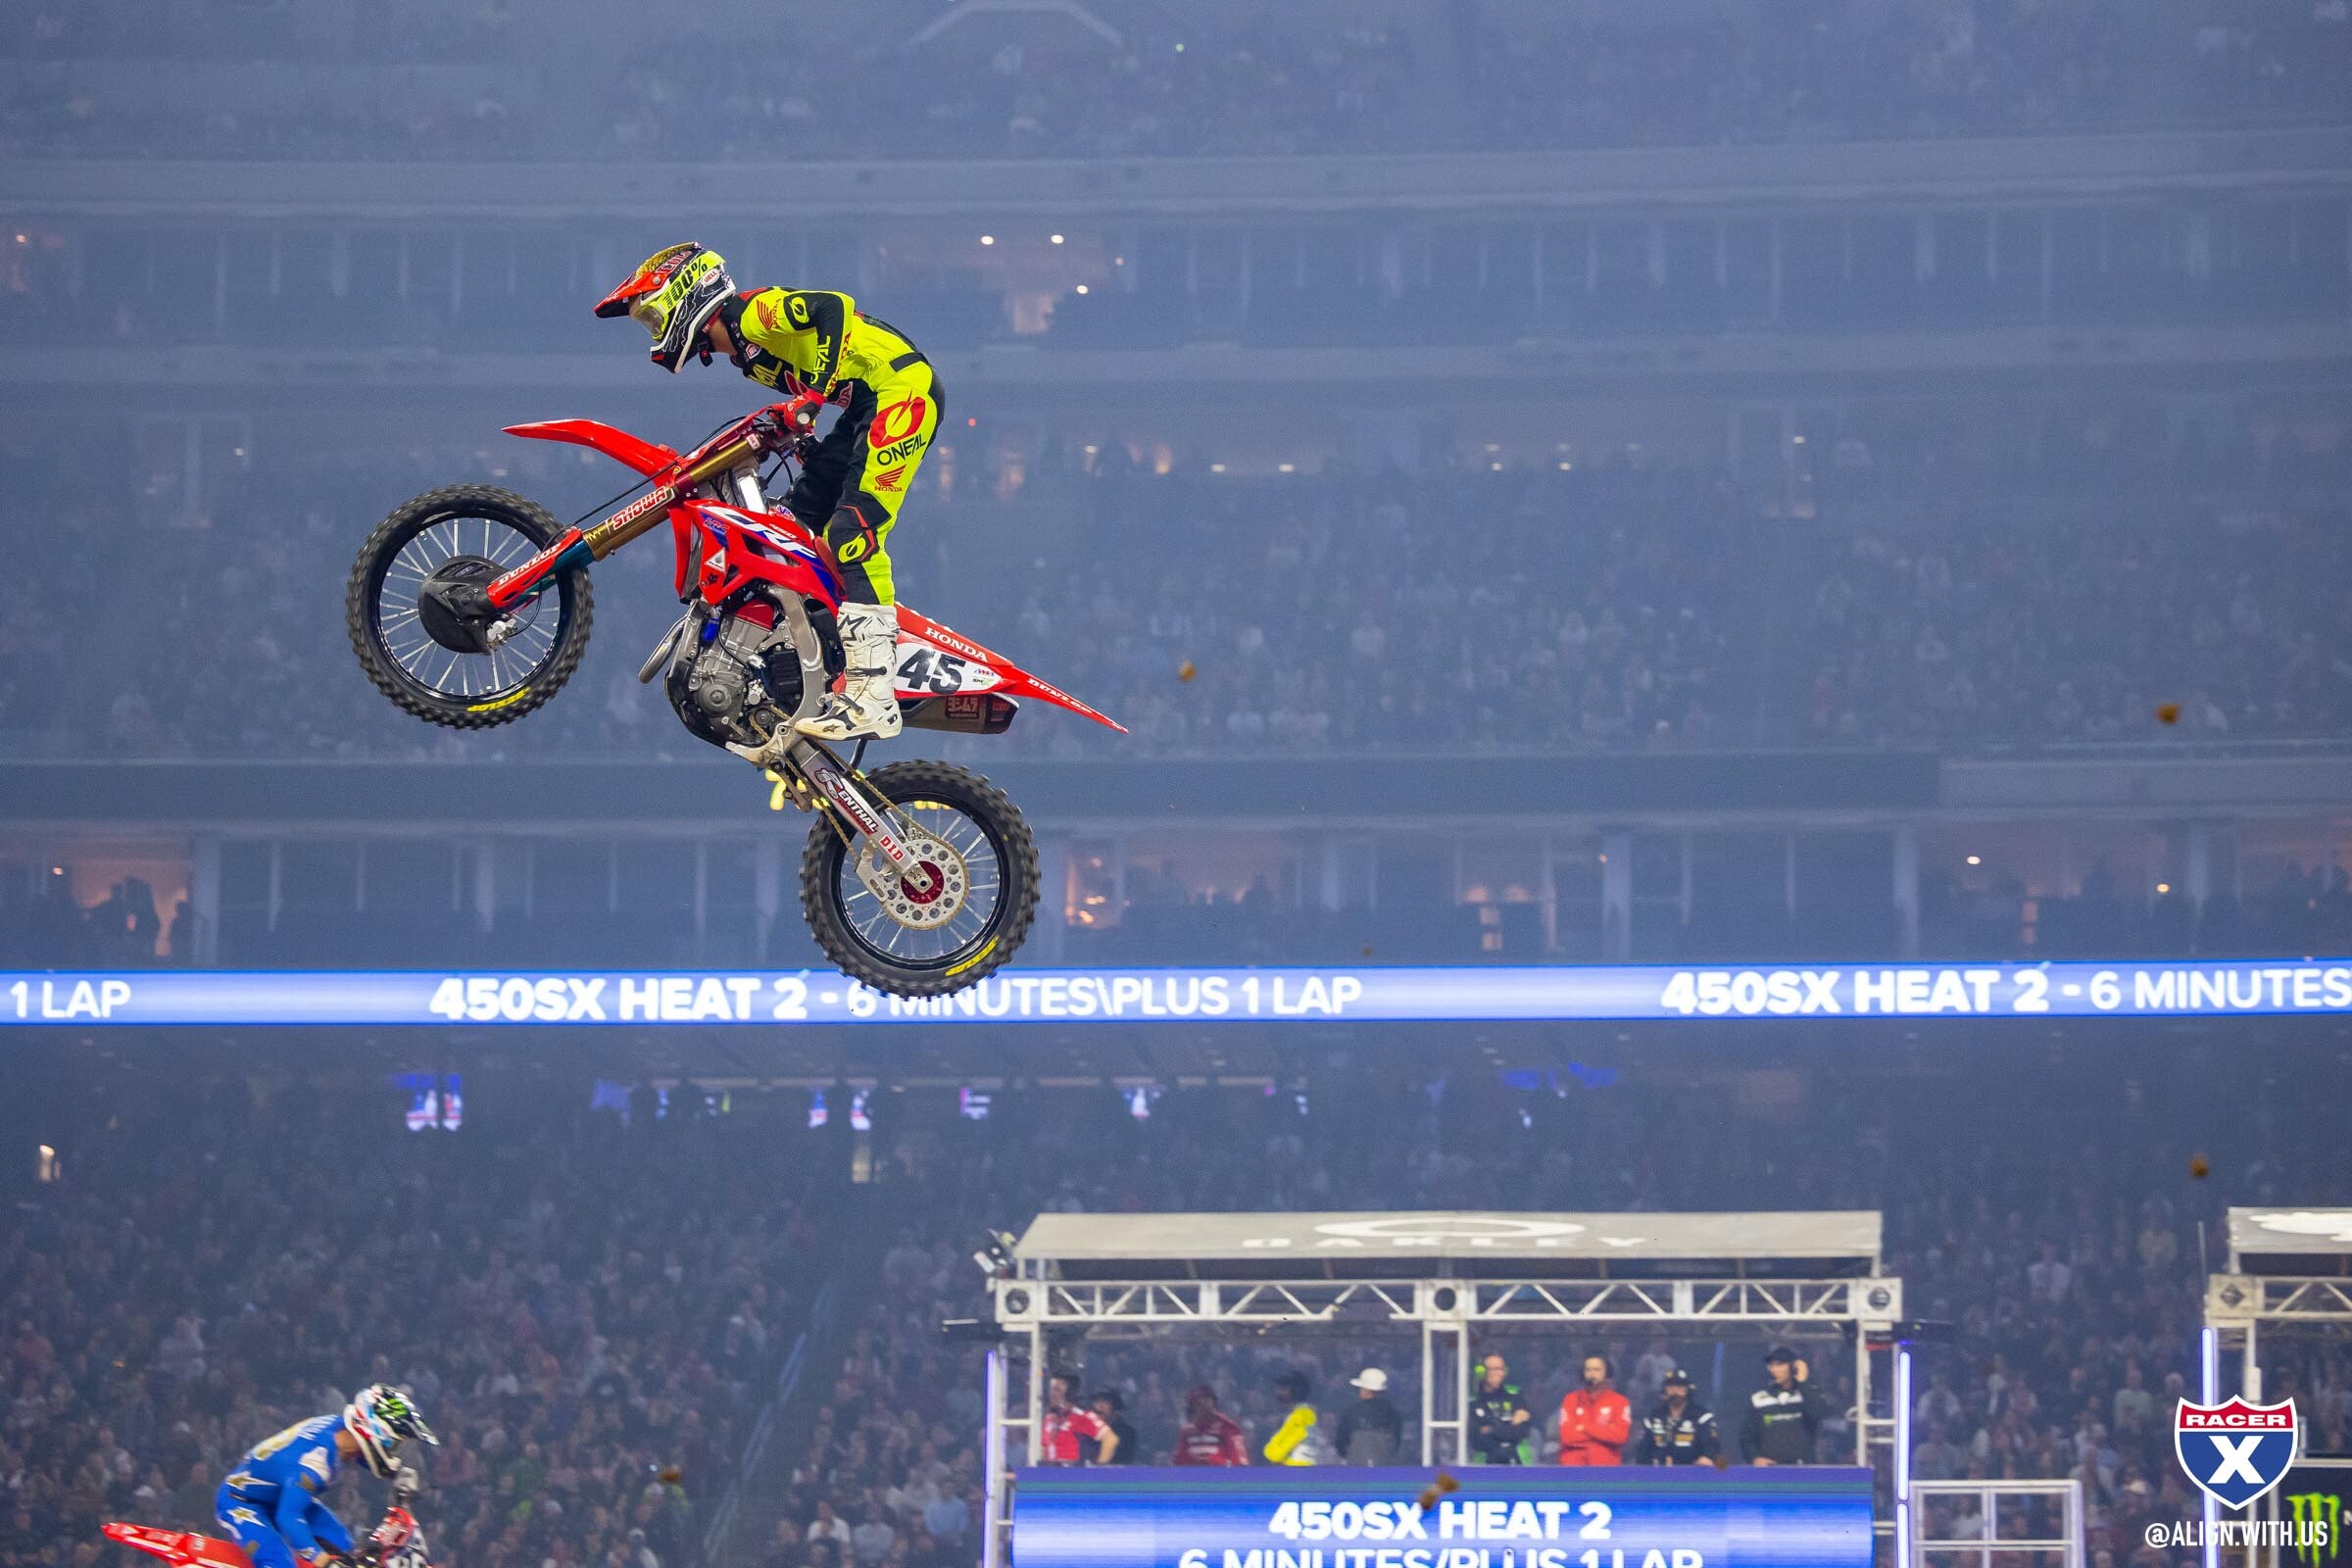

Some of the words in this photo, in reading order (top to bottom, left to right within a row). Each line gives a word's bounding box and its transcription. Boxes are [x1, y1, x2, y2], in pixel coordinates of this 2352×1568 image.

[662, 258, 708, 308] 100%
[876, 433, 927, 466] O'NEAL
[612, 485, 667, 530] SHOWA
[497, 543, 562, 586] DUNLOP
[924, 626, 989, 663] HONDA
[896, 648, 966, 696] 45
[1026, 677, 1093, 714] DUNLOP
[10, 981, 28, 1018] 1
[41, 980, 132, 1019] LAP
[429, 977, 606, 1021] 450SX
[618, 977, 762, 1021] HEAT
[771, 976, 808, 1020] 2
[847, 981, 878, 1018] 6
[1241, 976, 1260, 1015] 1
[1272, 976, 1363, 1016] LAP
[1659, 970, 1840, 1015] 450SX
[1853, 969, 2000, 1014] HEAT
[2013, 968, 2050, 1013] 2
[2089, 971, 2122, 1010] 6
[2134, 967, 2352, 1009] MINUTES
[1268, 1500, 1429, 1541] 450SX
[1439, 1500, 1568, 1541] HEAT
[1578, 1500, 1612, 1541] 2
